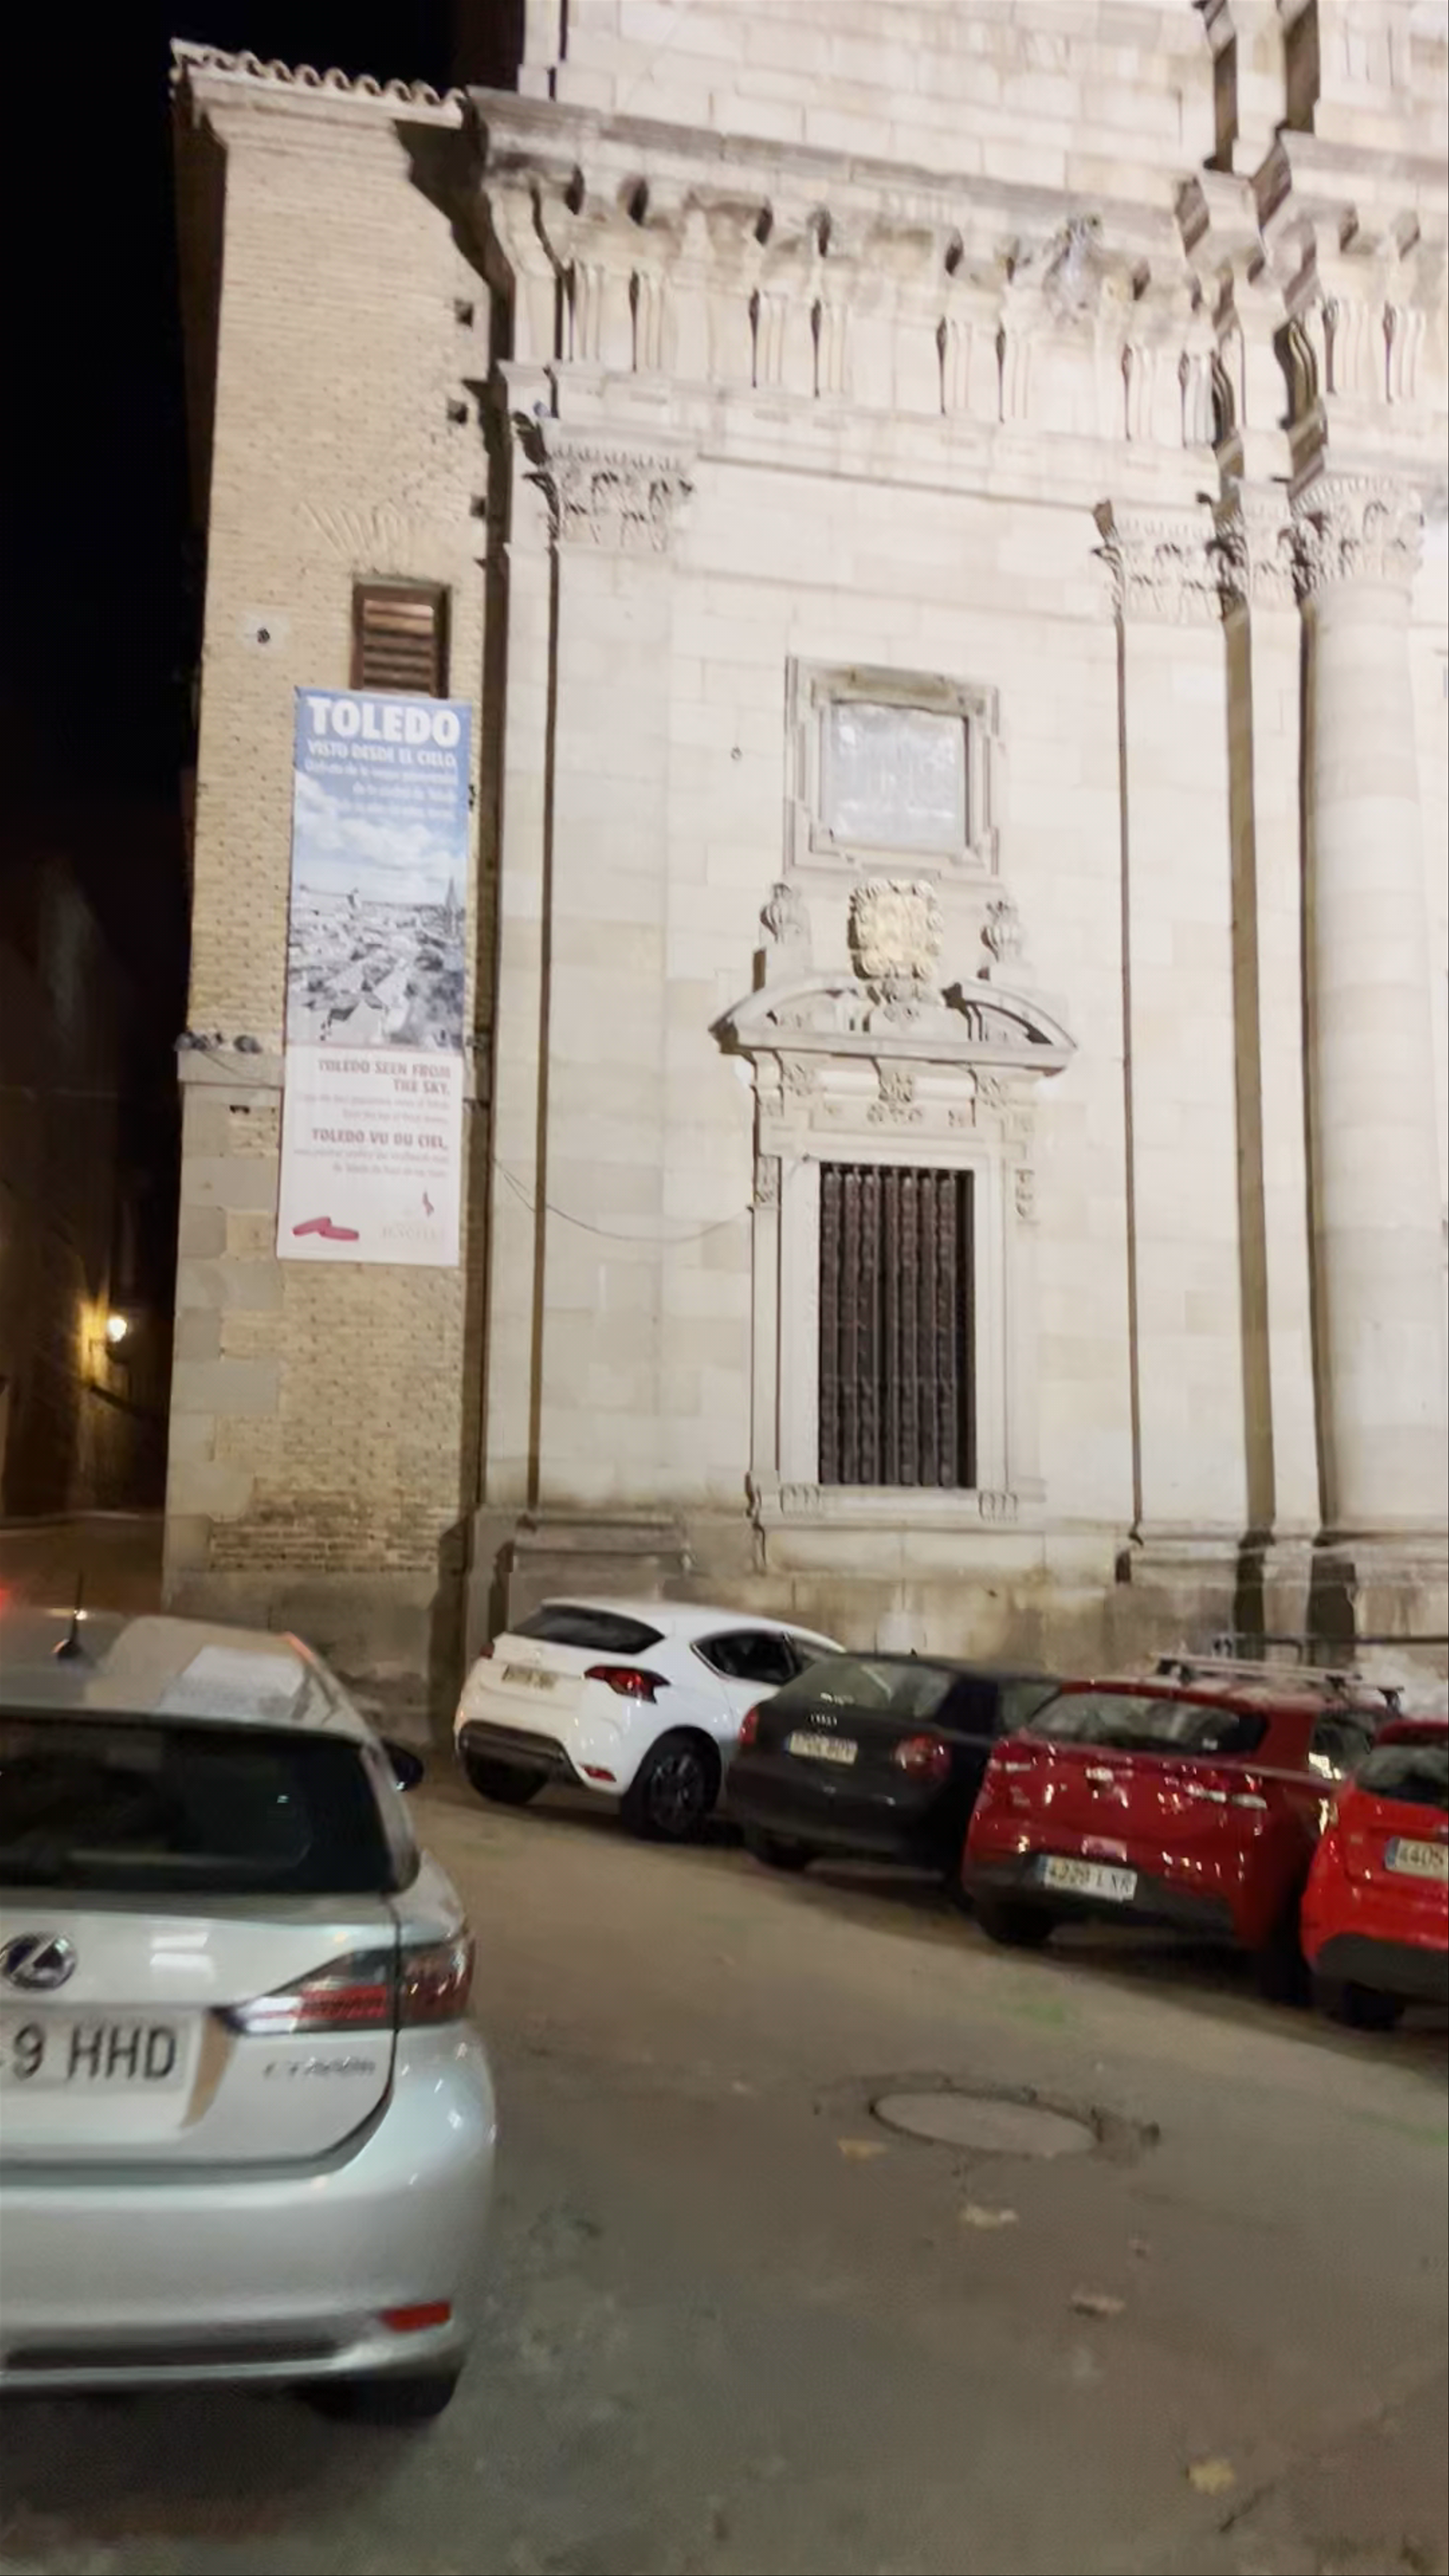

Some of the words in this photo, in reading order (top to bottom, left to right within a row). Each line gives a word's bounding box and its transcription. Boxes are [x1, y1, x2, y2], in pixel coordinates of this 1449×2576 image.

[306, 697, 460, 747] TOLEDO
[307, 738, 348, 758] VISTO
[351, 743, 394, 763] DESDE
[399, 747, 413, 764] EL
[417, 750, 457, 768] CIELO
[318, 1060, 370, 1073] TOLEDO
[375, 1061, 407, 1075] SEEN
[412, 1063, 451, 1078] FROM
[393, 1079, 417, 1093] THE
[312, 1128, 365, 1143] TOLEDO
[370, 1130, 388, 1145] VU
[394, 1132, 413, 1146] DU
[67, 2025, 176, 2081] HHD
